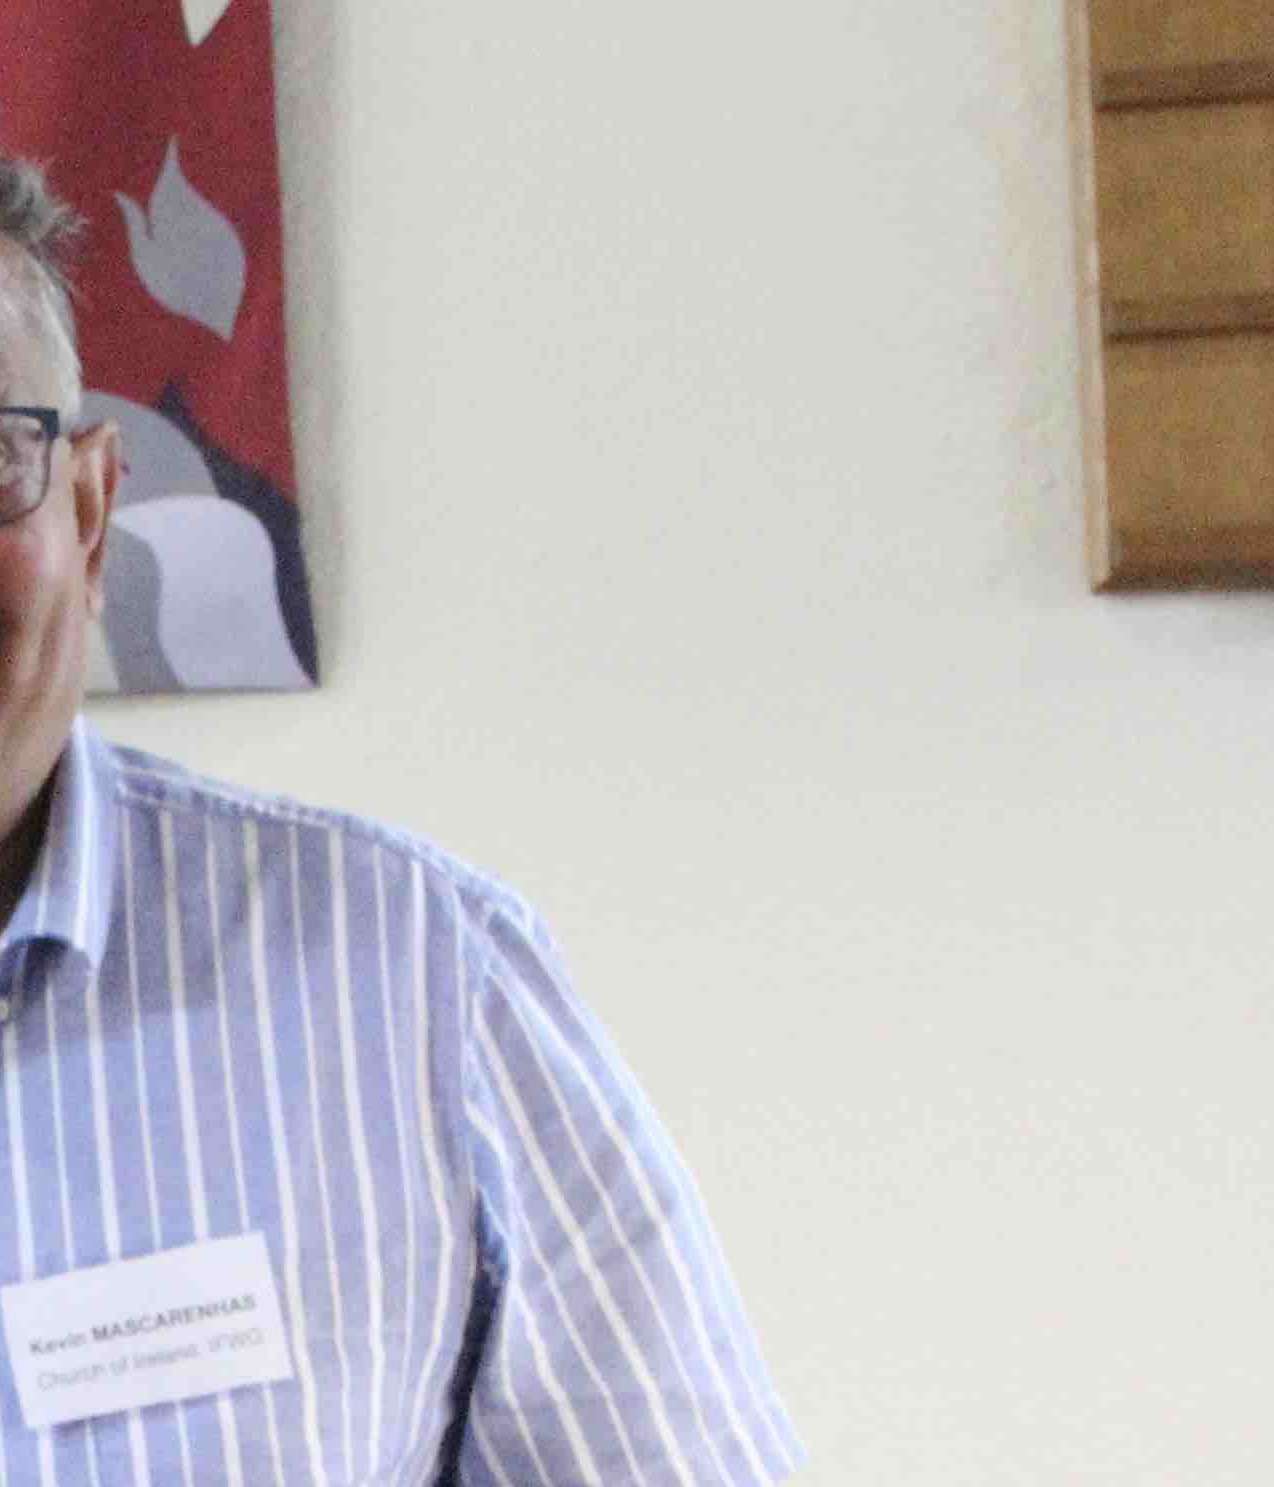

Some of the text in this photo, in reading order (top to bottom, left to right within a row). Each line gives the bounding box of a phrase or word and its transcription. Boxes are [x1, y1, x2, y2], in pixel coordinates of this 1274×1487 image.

[29, 1294, 256, 1356] Kevin MASCARENHAS
[38, 1362, 105, 1391] Church
[109, 1357, 129, 1377] of
